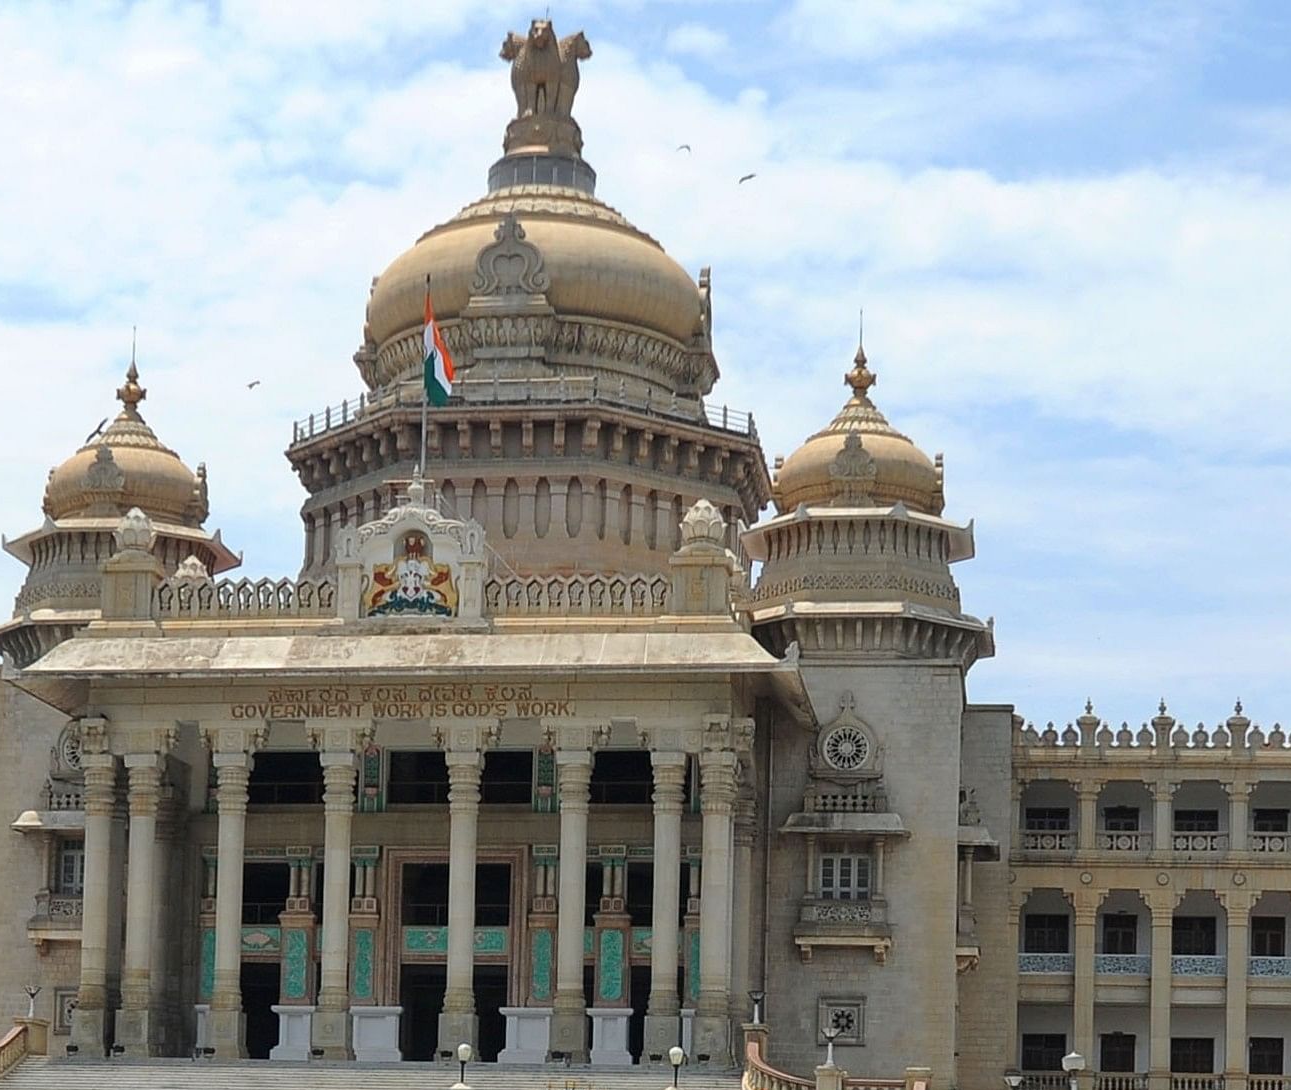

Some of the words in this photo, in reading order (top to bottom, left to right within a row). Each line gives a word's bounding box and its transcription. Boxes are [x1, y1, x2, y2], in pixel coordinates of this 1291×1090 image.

[231, 703, 364, 719] GOVERNMENT
[372, 702, 424, 718] WORK
[430, 703, 448, 717] IS
[452, 702, 508, 717] GOD'S
[515, 701, 577, 717] WORK.
